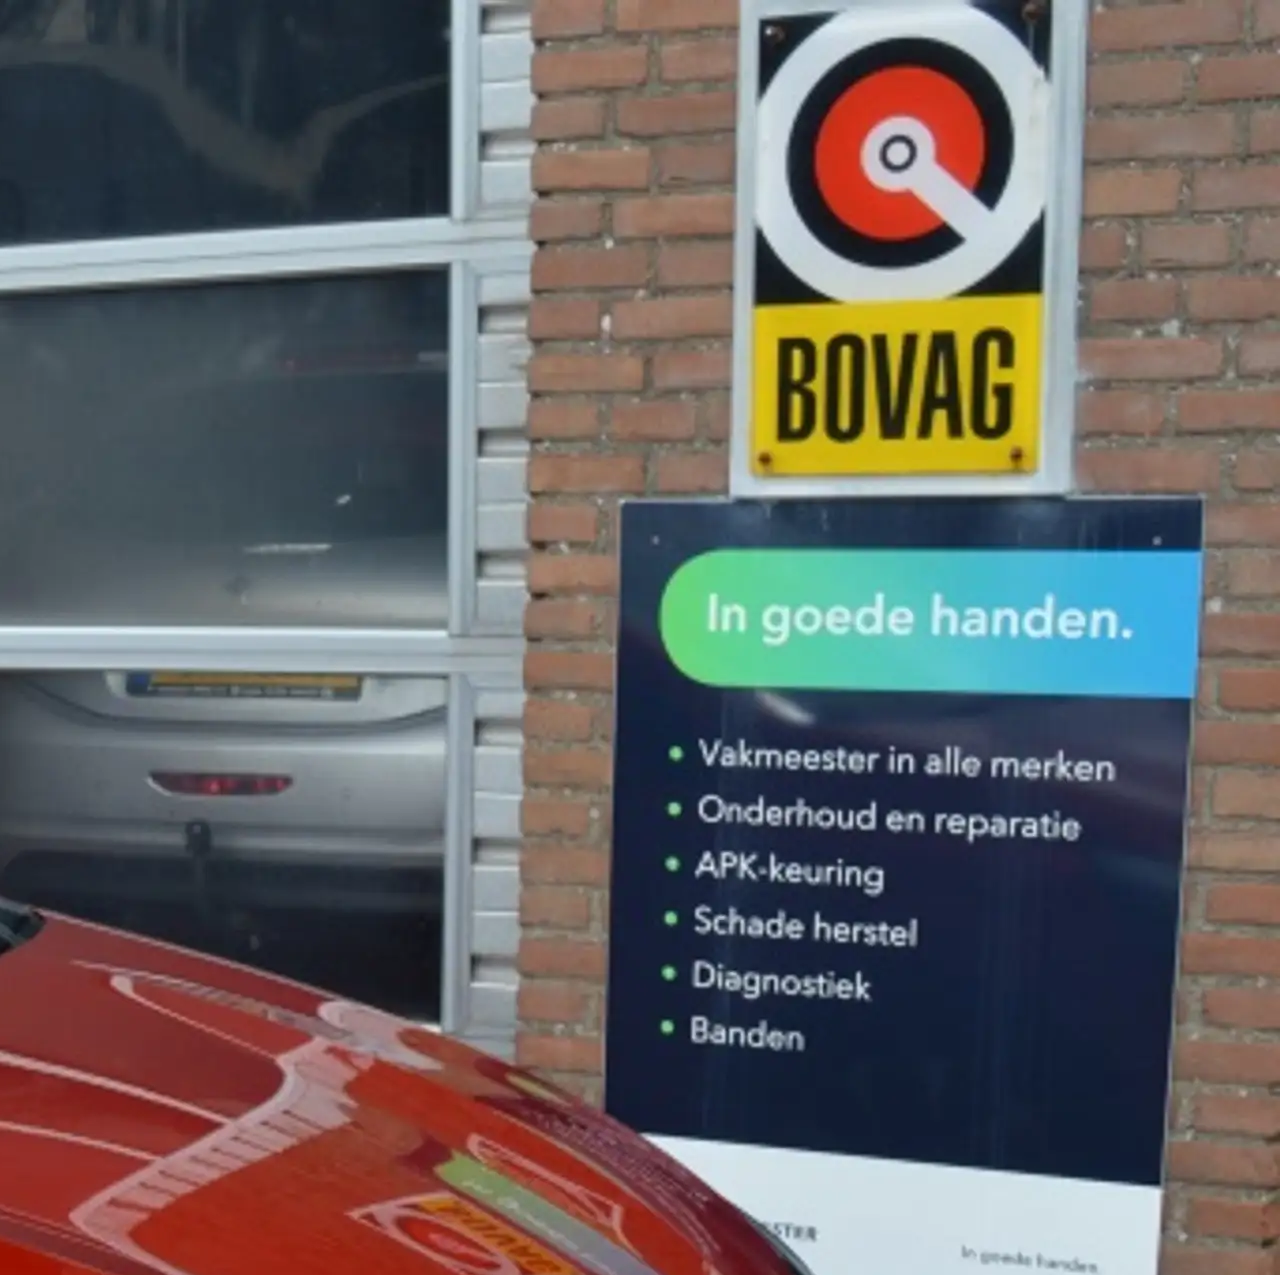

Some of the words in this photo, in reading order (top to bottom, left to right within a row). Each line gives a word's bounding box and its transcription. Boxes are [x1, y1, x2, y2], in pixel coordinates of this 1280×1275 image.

[776, 327, 1015, 443] BOVAG
[706, 593, 746, 633] In
[761, 594, 915, 646] goede
[930, 594, 1134, 640] handen.
[698, 739, 880, 775] Vakmeester
[887, 746, 916, 776] in
[924, 746, 982, 779] alle
[990, 752, 1116, 783] merken
[698, 796, 877, 832] Onderhoud
[886, 809, 925, 835] en
[934, 811, 1083, 844] reparatie
[694, 852, 885, 895] APK-keuring
[693, 907, 805, 942] Schade
[813, 914, 919, 948] herstel
[692, 961, 871, 1001] Diagnostiek
[690, 1017, 805, 1052] Banden
